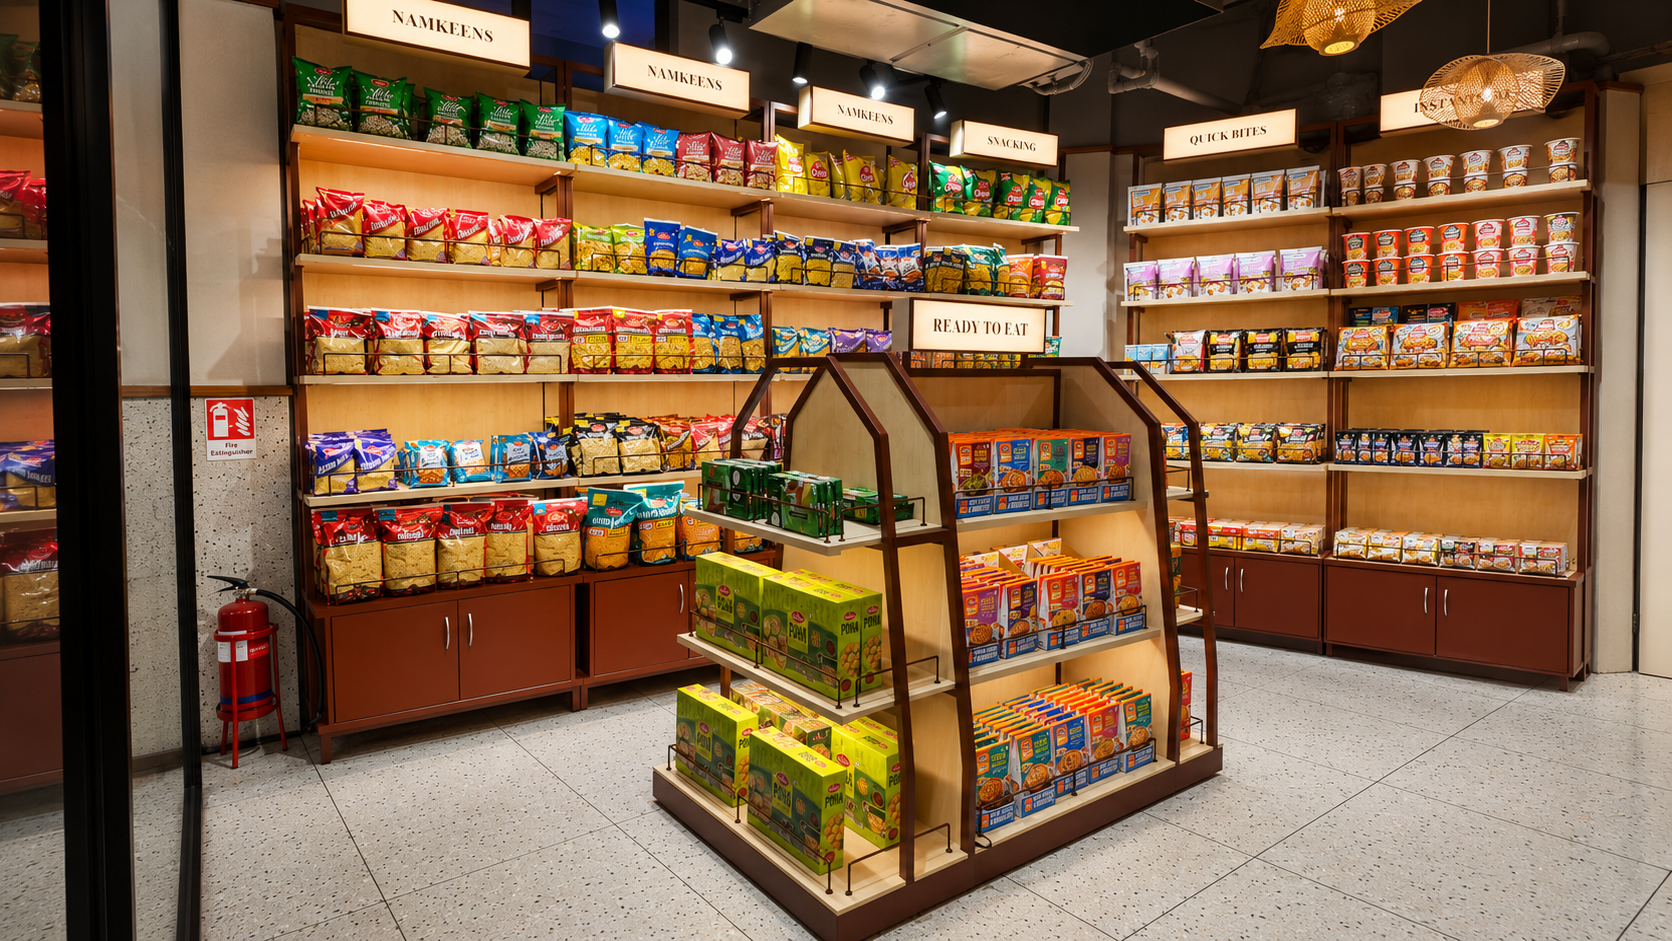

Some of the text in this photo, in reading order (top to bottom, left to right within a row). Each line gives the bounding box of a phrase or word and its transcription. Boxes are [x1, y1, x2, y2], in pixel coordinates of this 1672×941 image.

[392, 9, 494, 43] NAMKEENS
[647, 64, 723, 91] NAMKEENS
[837, 104, 894, 125] NAMKEENS
[987, 135, 1037, 152] SNACKING
[1189, 125, 1267, 146] QUICK BITES
[933, 318, 1029, 336] READY TO EAT
